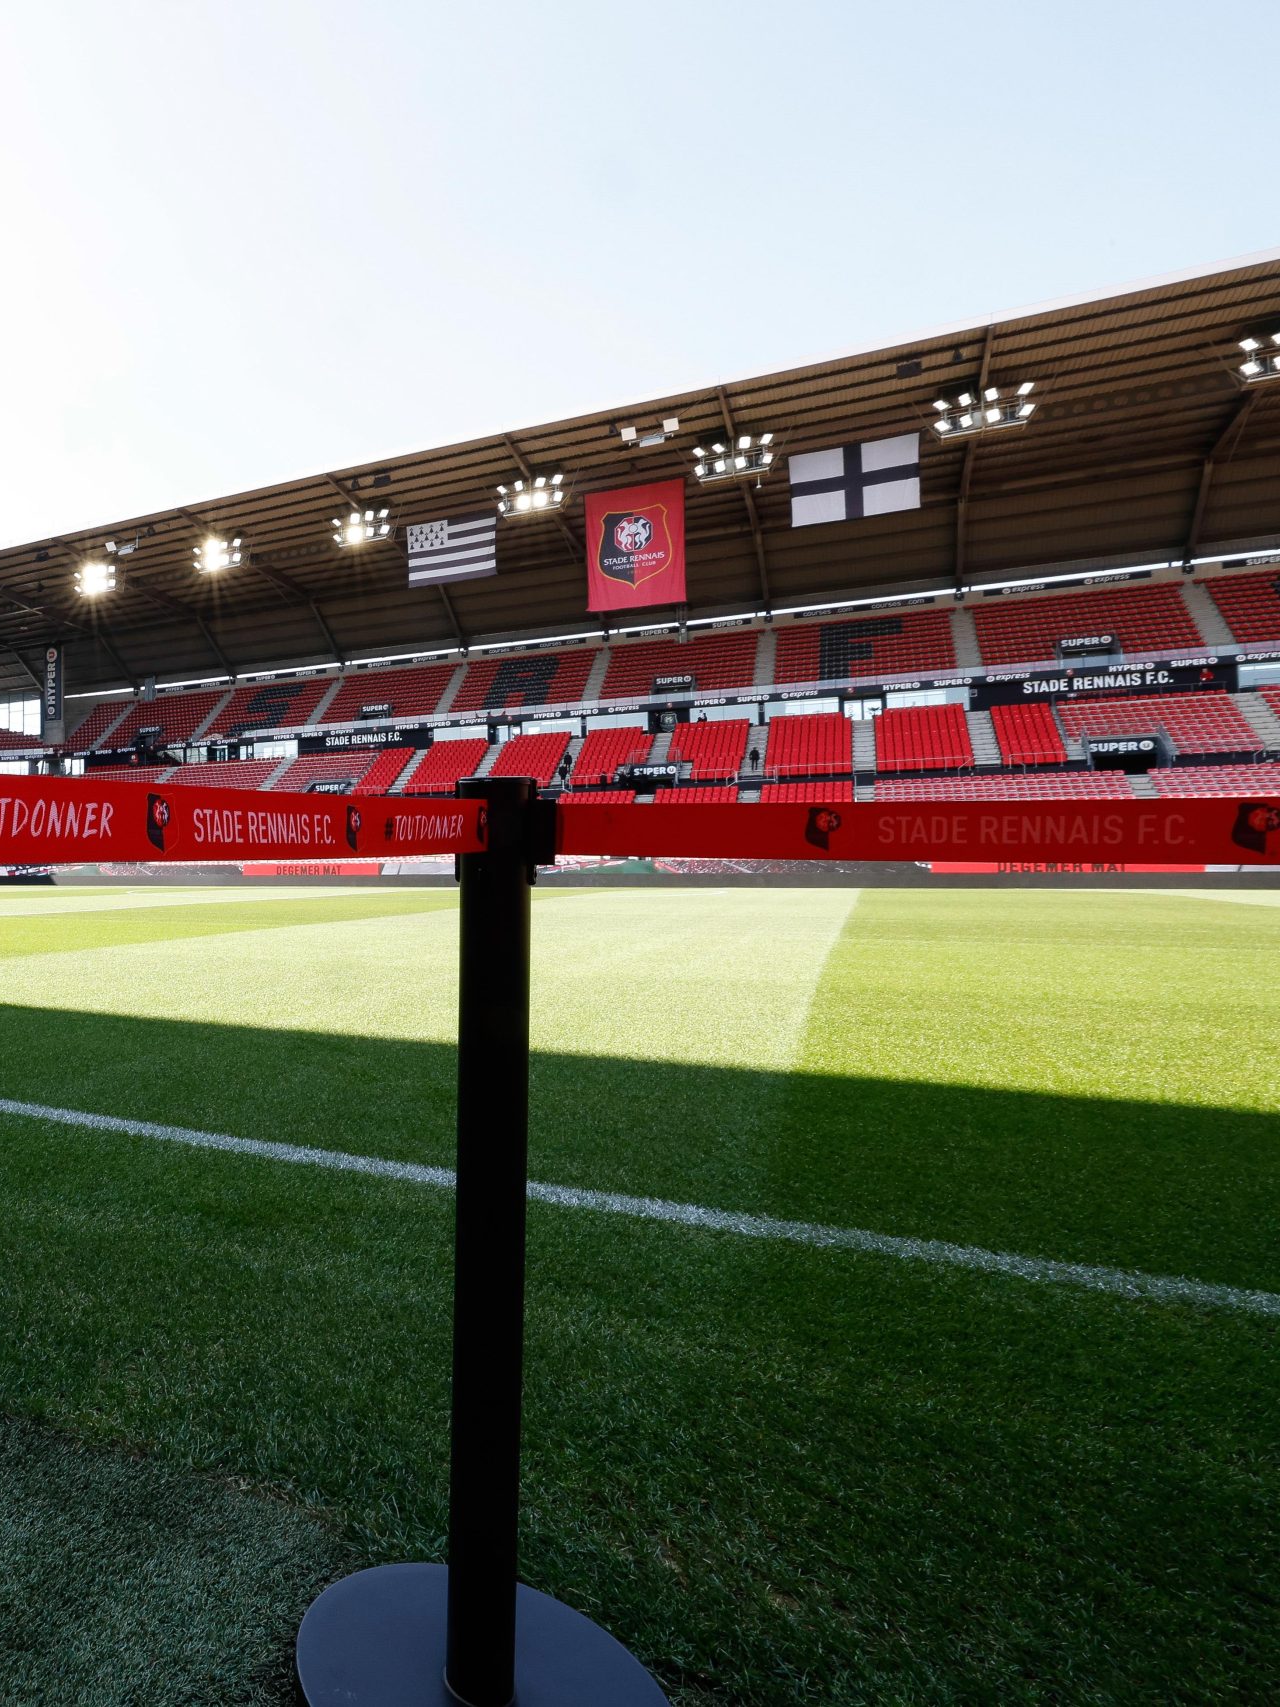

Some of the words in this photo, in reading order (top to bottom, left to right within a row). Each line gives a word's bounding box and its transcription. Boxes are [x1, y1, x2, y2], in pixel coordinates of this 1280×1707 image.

[604, 556, 629, 566] STADE
[630, 552, 665, 562] RENNAIS
[1094, 573, 1130, 583] express
[1012, 583, 1045, 593] express
[712, 620, 736, 628] SUPER
[1061, 637, 1100, 648] SUPER
[1108, 664, 1144, 672] HYPER
[1170, 658, 1208, 668] SUPER
[47, 662, 56, 704] HYPER
[656, 676, 683, 684] SUPER
[934, 679, 964, 687] SUPER
[996, 672, 1030, 682] express
[1022, 678, 1070, 694] STADE
[1072, 672, 1142, 690] RENNAIS
[1145, 670, 1174, 685] F.C.
[737, 695, 762, 703] SUPER
[790, 690, 818, 698] express
[325, 736, 350, 746] STADE
[351, 732, 386, 744] RENNAIS
[388, 732, 402, 742] F.C.
[1088, 742, 1138, 752] SUPER
[193, 808, 243, 844] STADE
[247, 810, 312, 844] RENNAIS
[315, 814, 336, 844] F.C.
[384, 814, 464, 842] #TOUTDONNER
[877, 816, 968, 844] STADE
[979, 814, 1123, 844] RENNAIS
[1138, 814, 1196, 845] F.C.
[276, 865, 320, 876] DEGEMER
[323, 865, 342, 876] MAT
[998, 862, 1084, 872] DEGEMER
